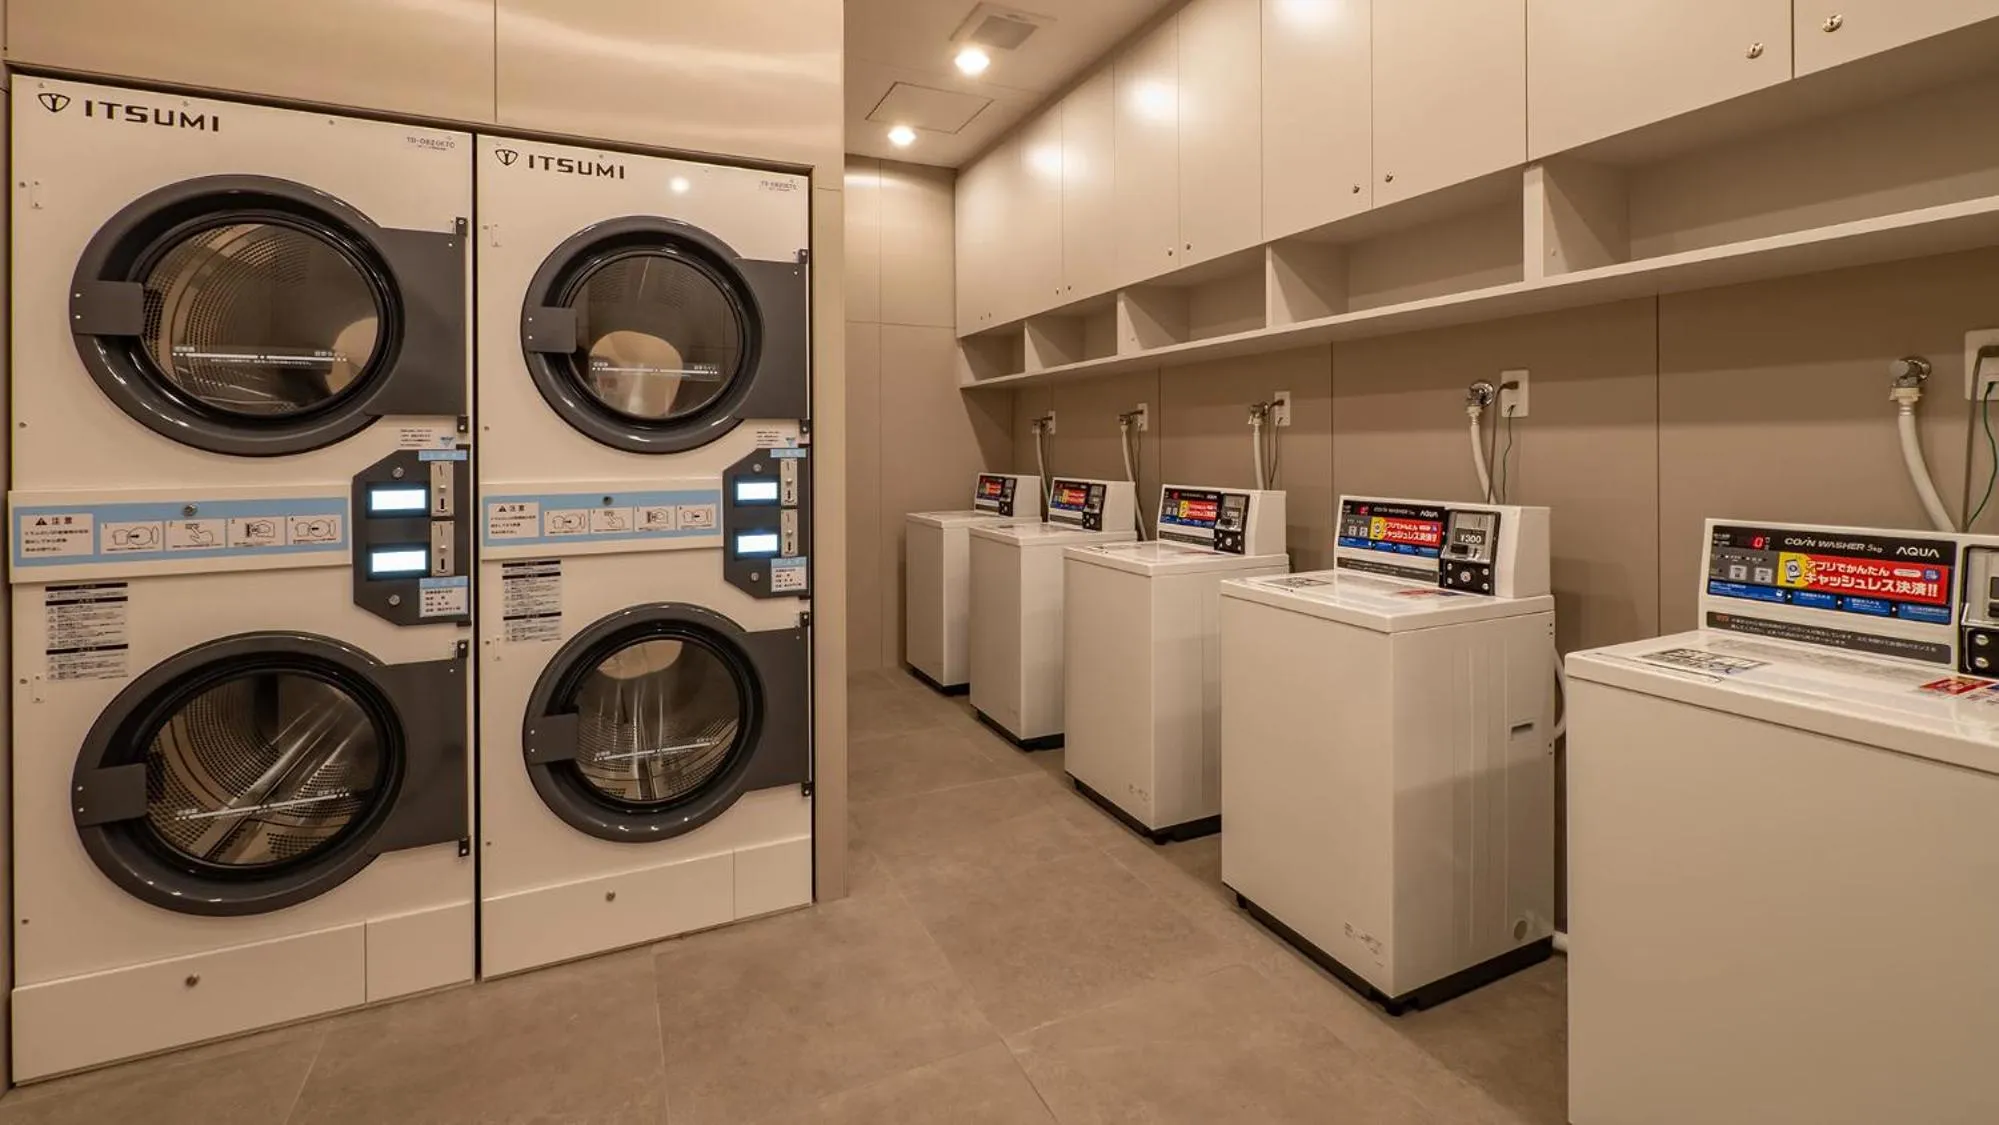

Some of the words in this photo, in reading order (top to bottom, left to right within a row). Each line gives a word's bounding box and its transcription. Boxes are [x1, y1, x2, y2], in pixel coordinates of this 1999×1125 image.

[85, 100, 219, 132] ITSUMI
[528, 154, 624, 179] ITSUMI
[1753, 536, 1764, 548] 0
[1817, 540, 1866, 551] WASHER
[1896, 546, 1940, 558] AQUA
[1806, 560, 1890, 577] アプリでかんたん
